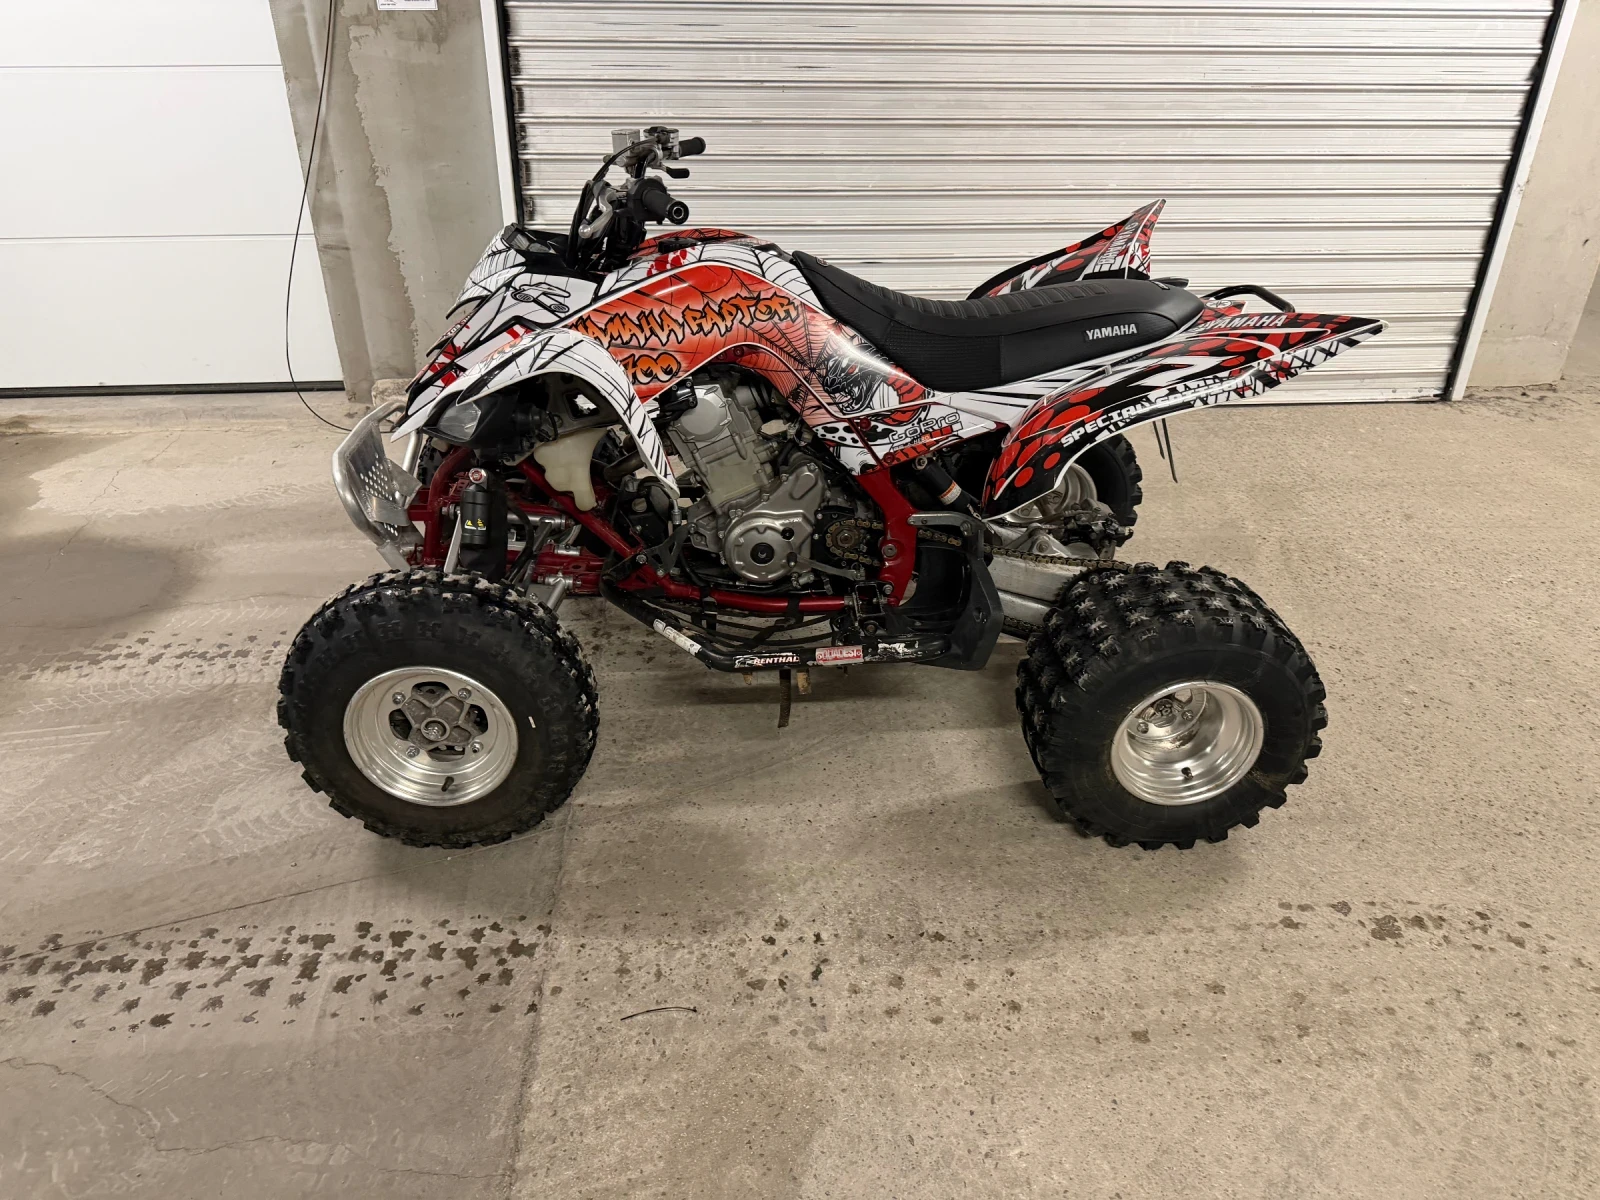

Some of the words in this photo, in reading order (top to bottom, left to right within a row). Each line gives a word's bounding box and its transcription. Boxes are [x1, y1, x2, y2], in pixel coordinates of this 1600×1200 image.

[681, 292, 800, 337] RAPTOR
[1206, 314, 1289, 329] YAMAHA
[1085, 323, 1138, 341] YAMAHA
[619, 352, 681, 386] 700
[888, 411, 961, 444] GoPro
[1060, 399, 1152, 448] SPECIAL
[752, 656, 800, 666] RENTHAL
